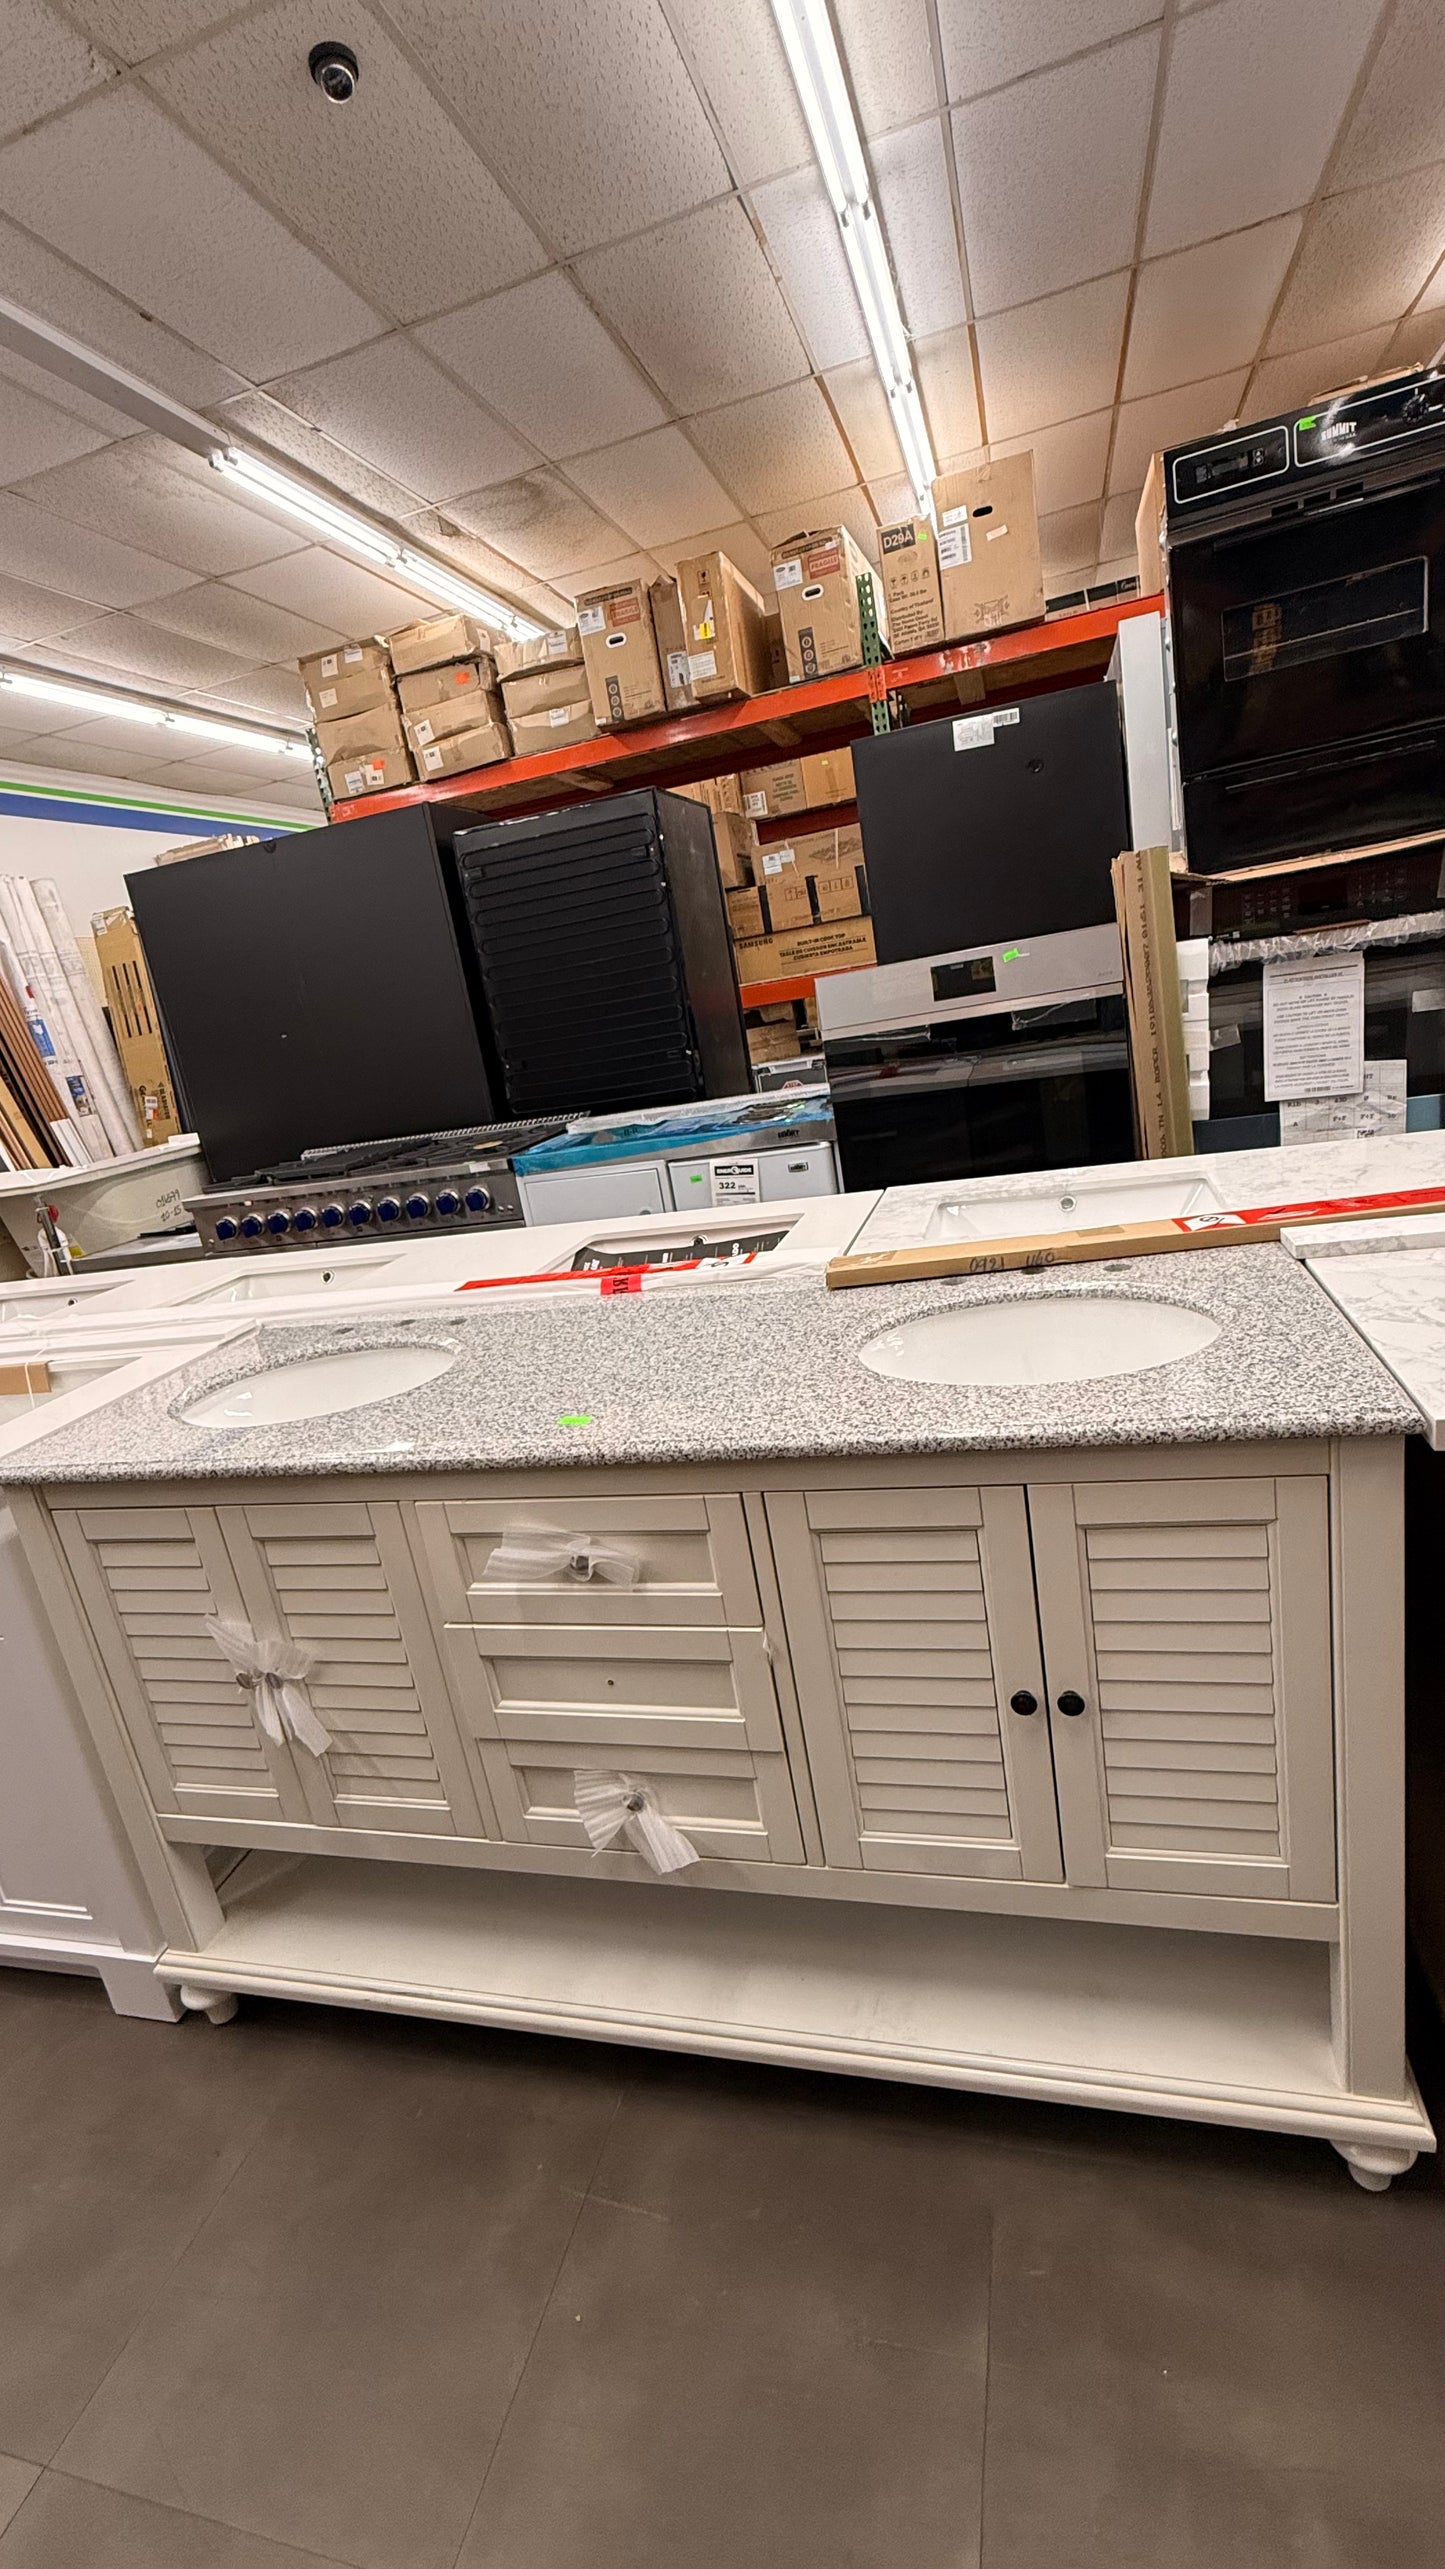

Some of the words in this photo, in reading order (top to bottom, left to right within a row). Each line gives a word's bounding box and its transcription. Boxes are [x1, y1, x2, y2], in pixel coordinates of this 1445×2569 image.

[1321, 421, 1357, 440] SUMMIT
[883, 529, 914, 549] D29A
[739, 937, 774, 950] SAMSUNG
